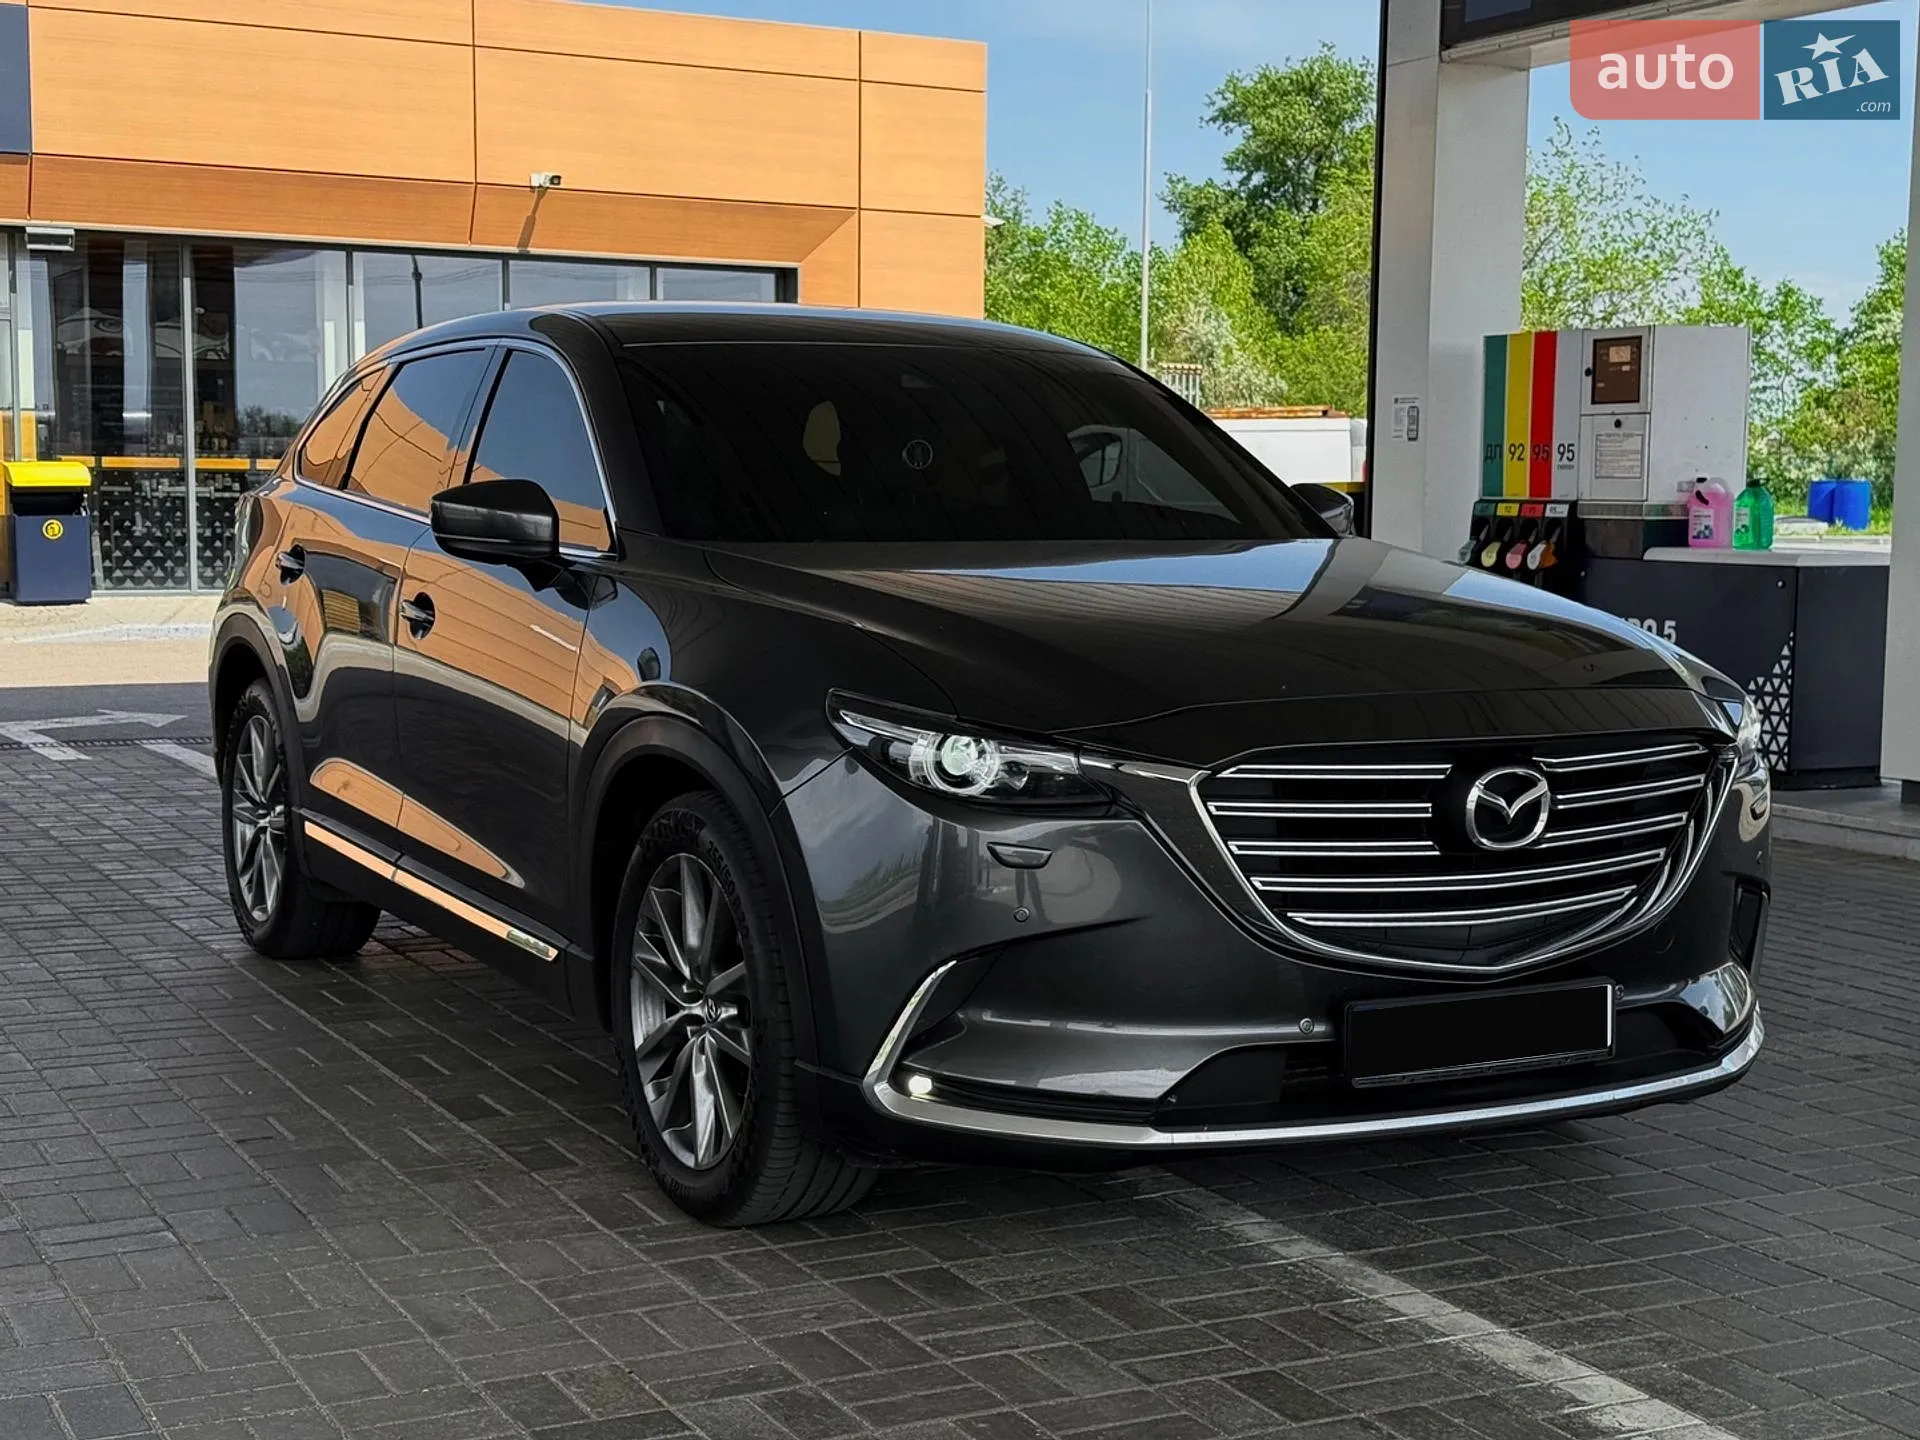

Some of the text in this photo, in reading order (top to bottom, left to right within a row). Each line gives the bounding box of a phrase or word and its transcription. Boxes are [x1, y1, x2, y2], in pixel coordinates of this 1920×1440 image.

[1485, 443, 1503, 463] ДП
[1508, 442, 1525, 462] 92
[1532, 443, 1551, 463] 95
[1557, 443, 1575, 462] 95
[1663, 620, 1677, 643] 5
